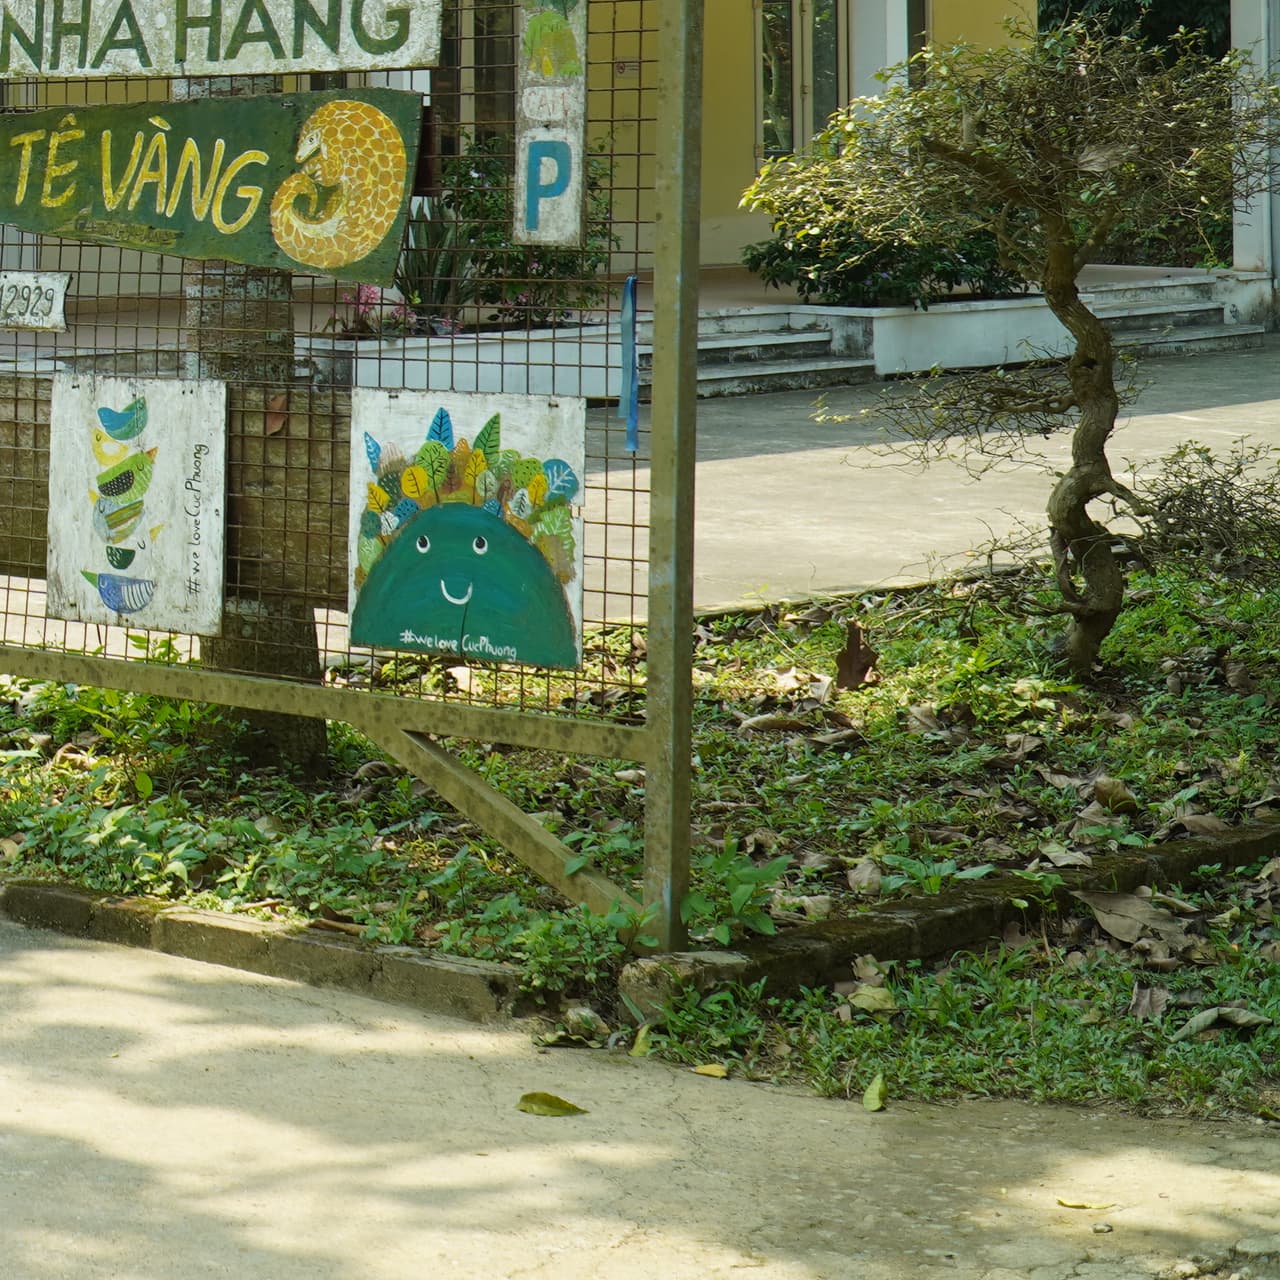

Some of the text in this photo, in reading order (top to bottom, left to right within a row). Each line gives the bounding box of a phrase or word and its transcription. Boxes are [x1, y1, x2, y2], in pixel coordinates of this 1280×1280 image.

[9, 112, 86, 209] TÊ
[100, 115, 270, 236] VÀNG
[524, 140, 573, 232] P
